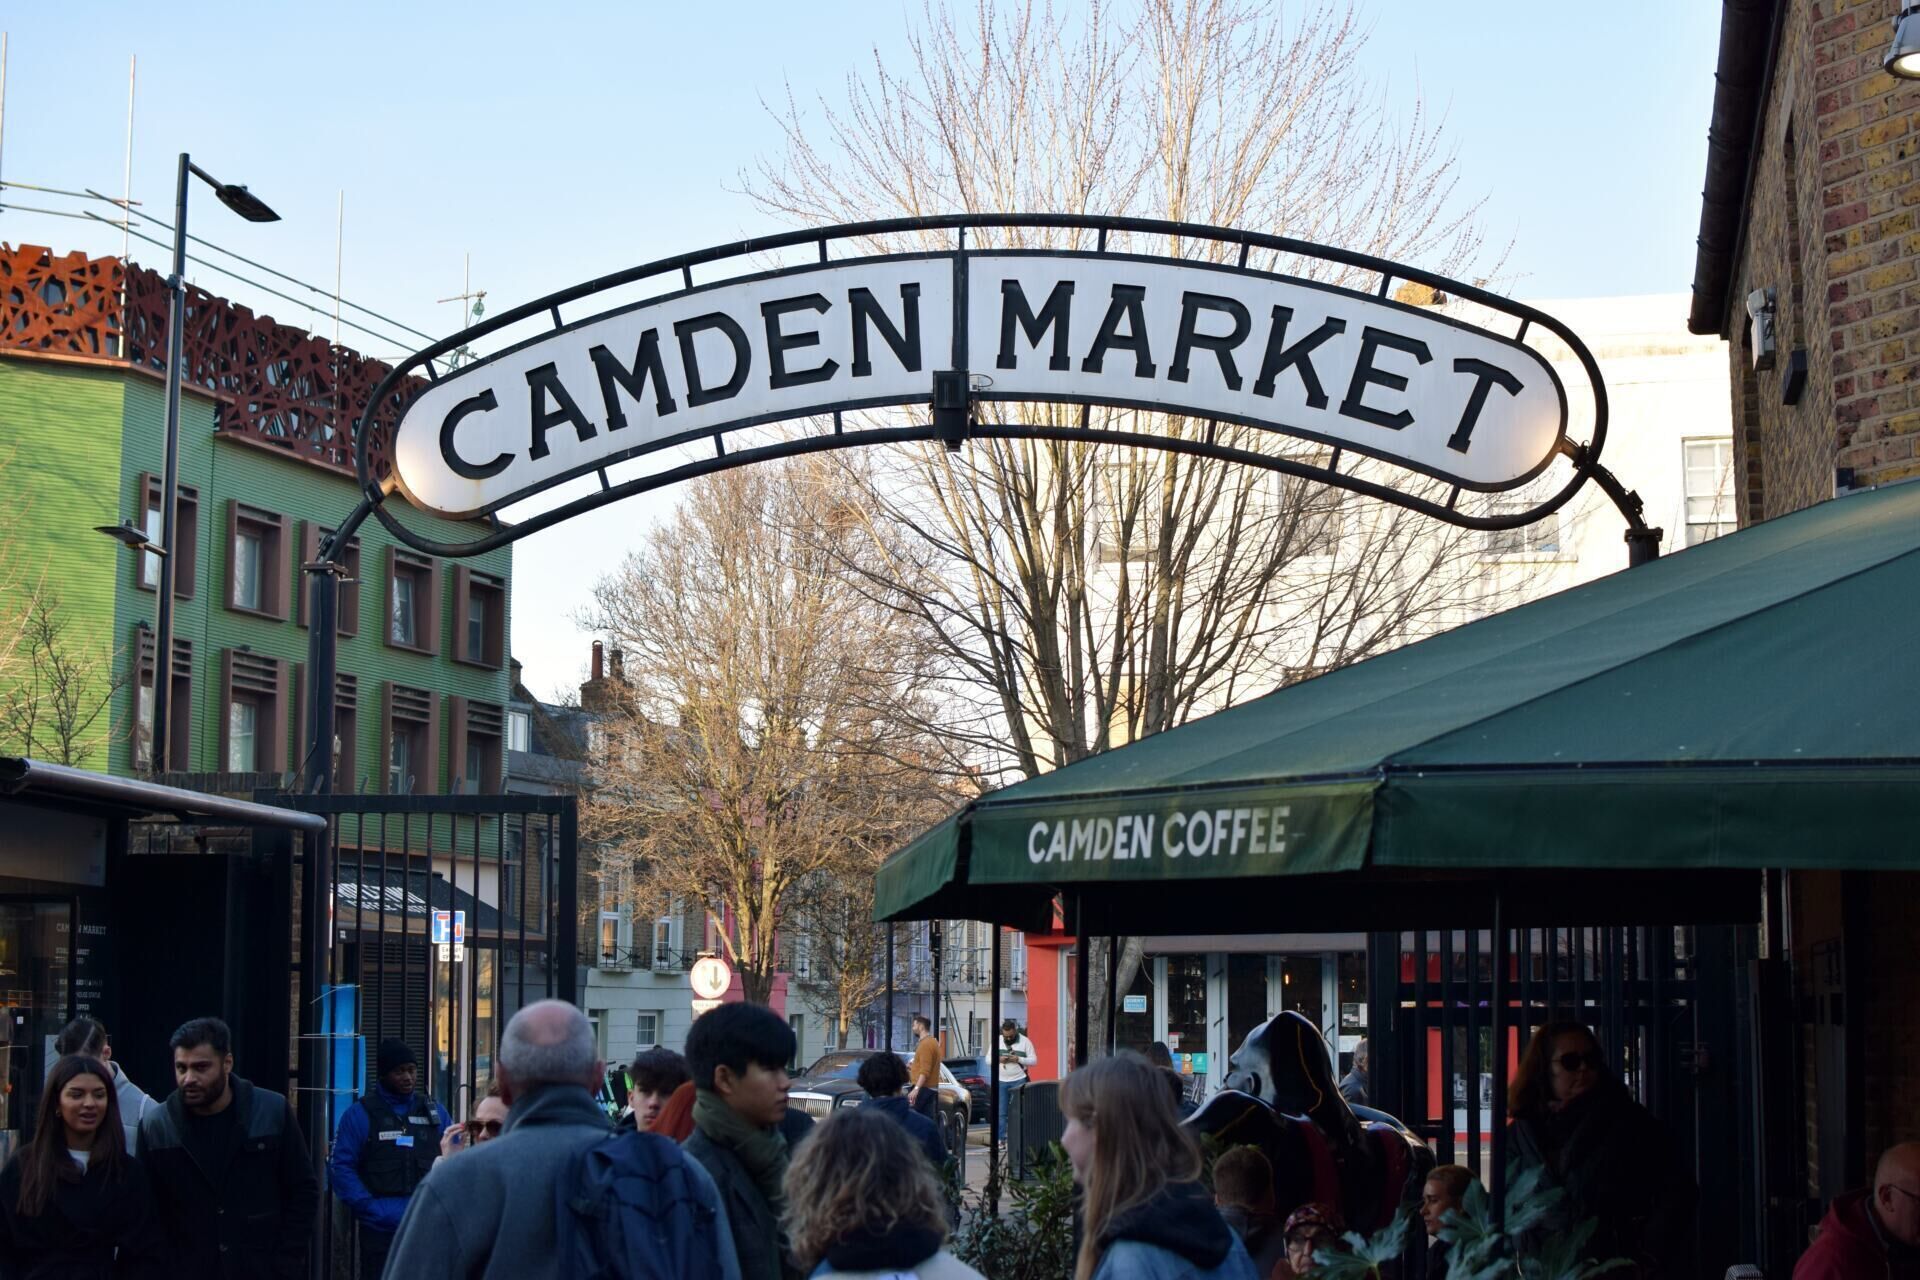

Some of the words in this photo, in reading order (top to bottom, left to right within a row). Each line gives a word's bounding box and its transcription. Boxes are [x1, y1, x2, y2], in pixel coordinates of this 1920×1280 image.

[439, 282, 922, 480] CAMDEN
[995, 279, 1525, 455] MARKET
[1027, 814, 1156, 865] CAMDEN
[1162, 806, 1291, 858] COFFEE
[56, 922, 82, 933] CAMN
[82, 924, 107, 935] MARKET
